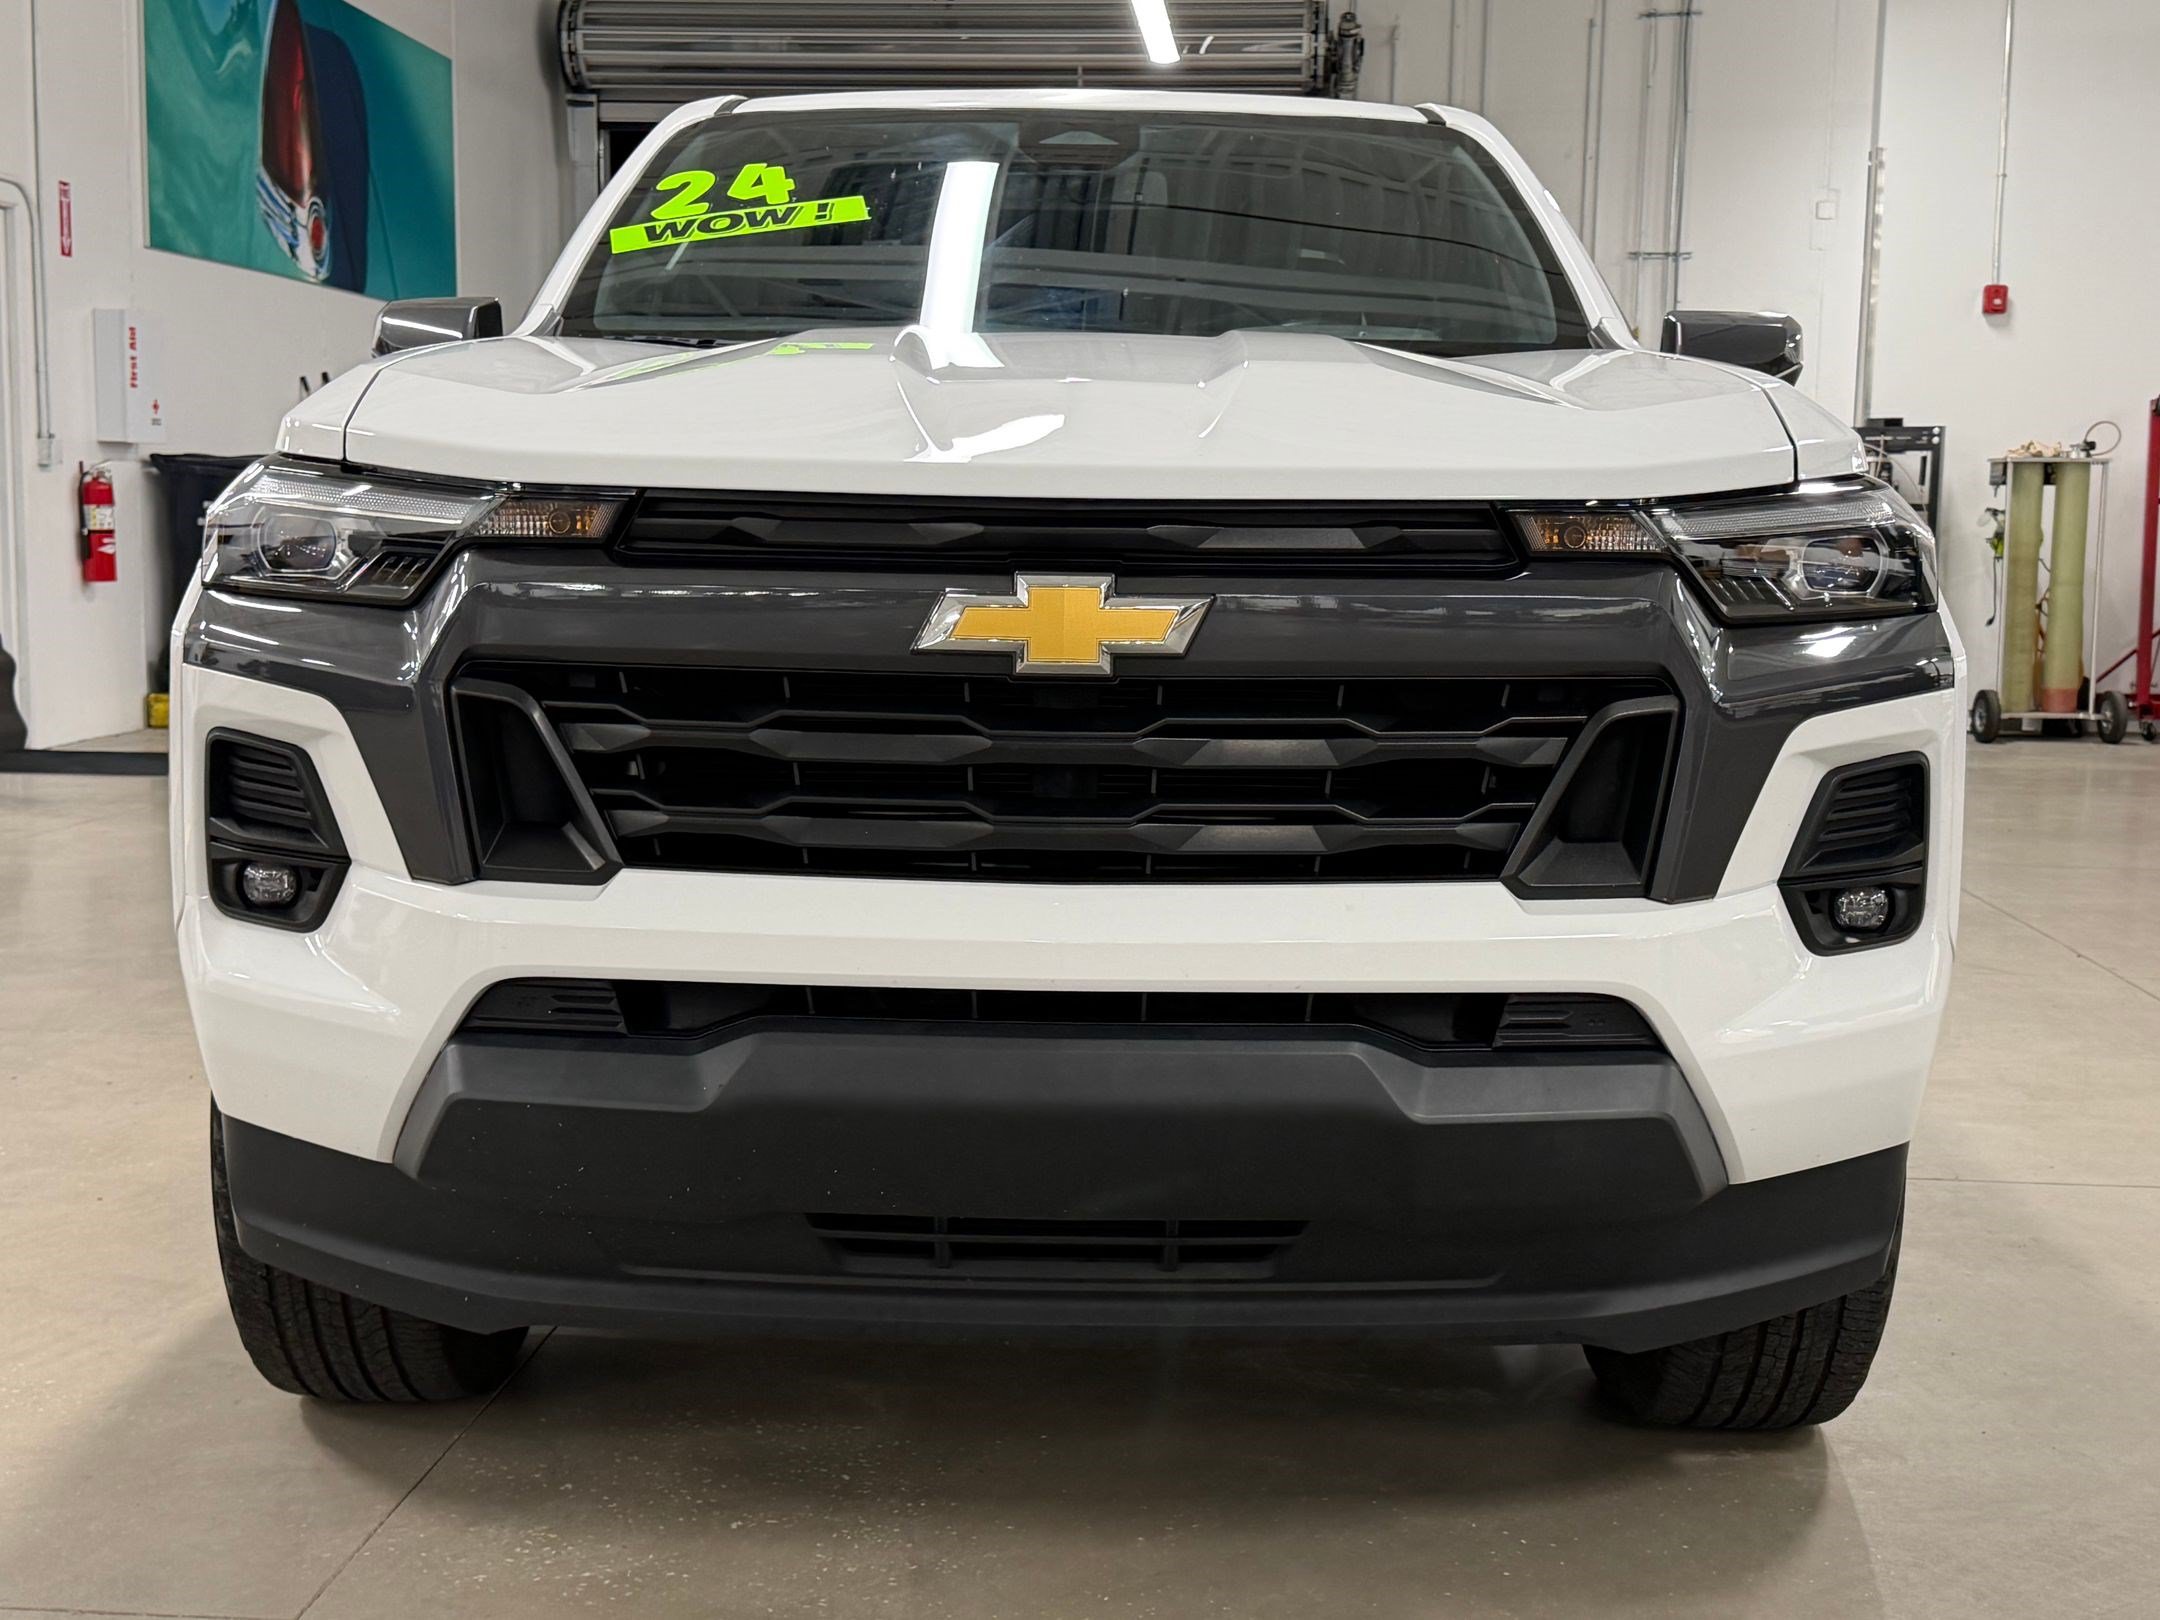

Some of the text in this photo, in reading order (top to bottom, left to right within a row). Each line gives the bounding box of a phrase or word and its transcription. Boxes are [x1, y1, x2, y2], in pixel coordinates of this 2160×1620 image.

[650, 162, 796, 220] 24
[128, 326, 138, 389] First Aid
